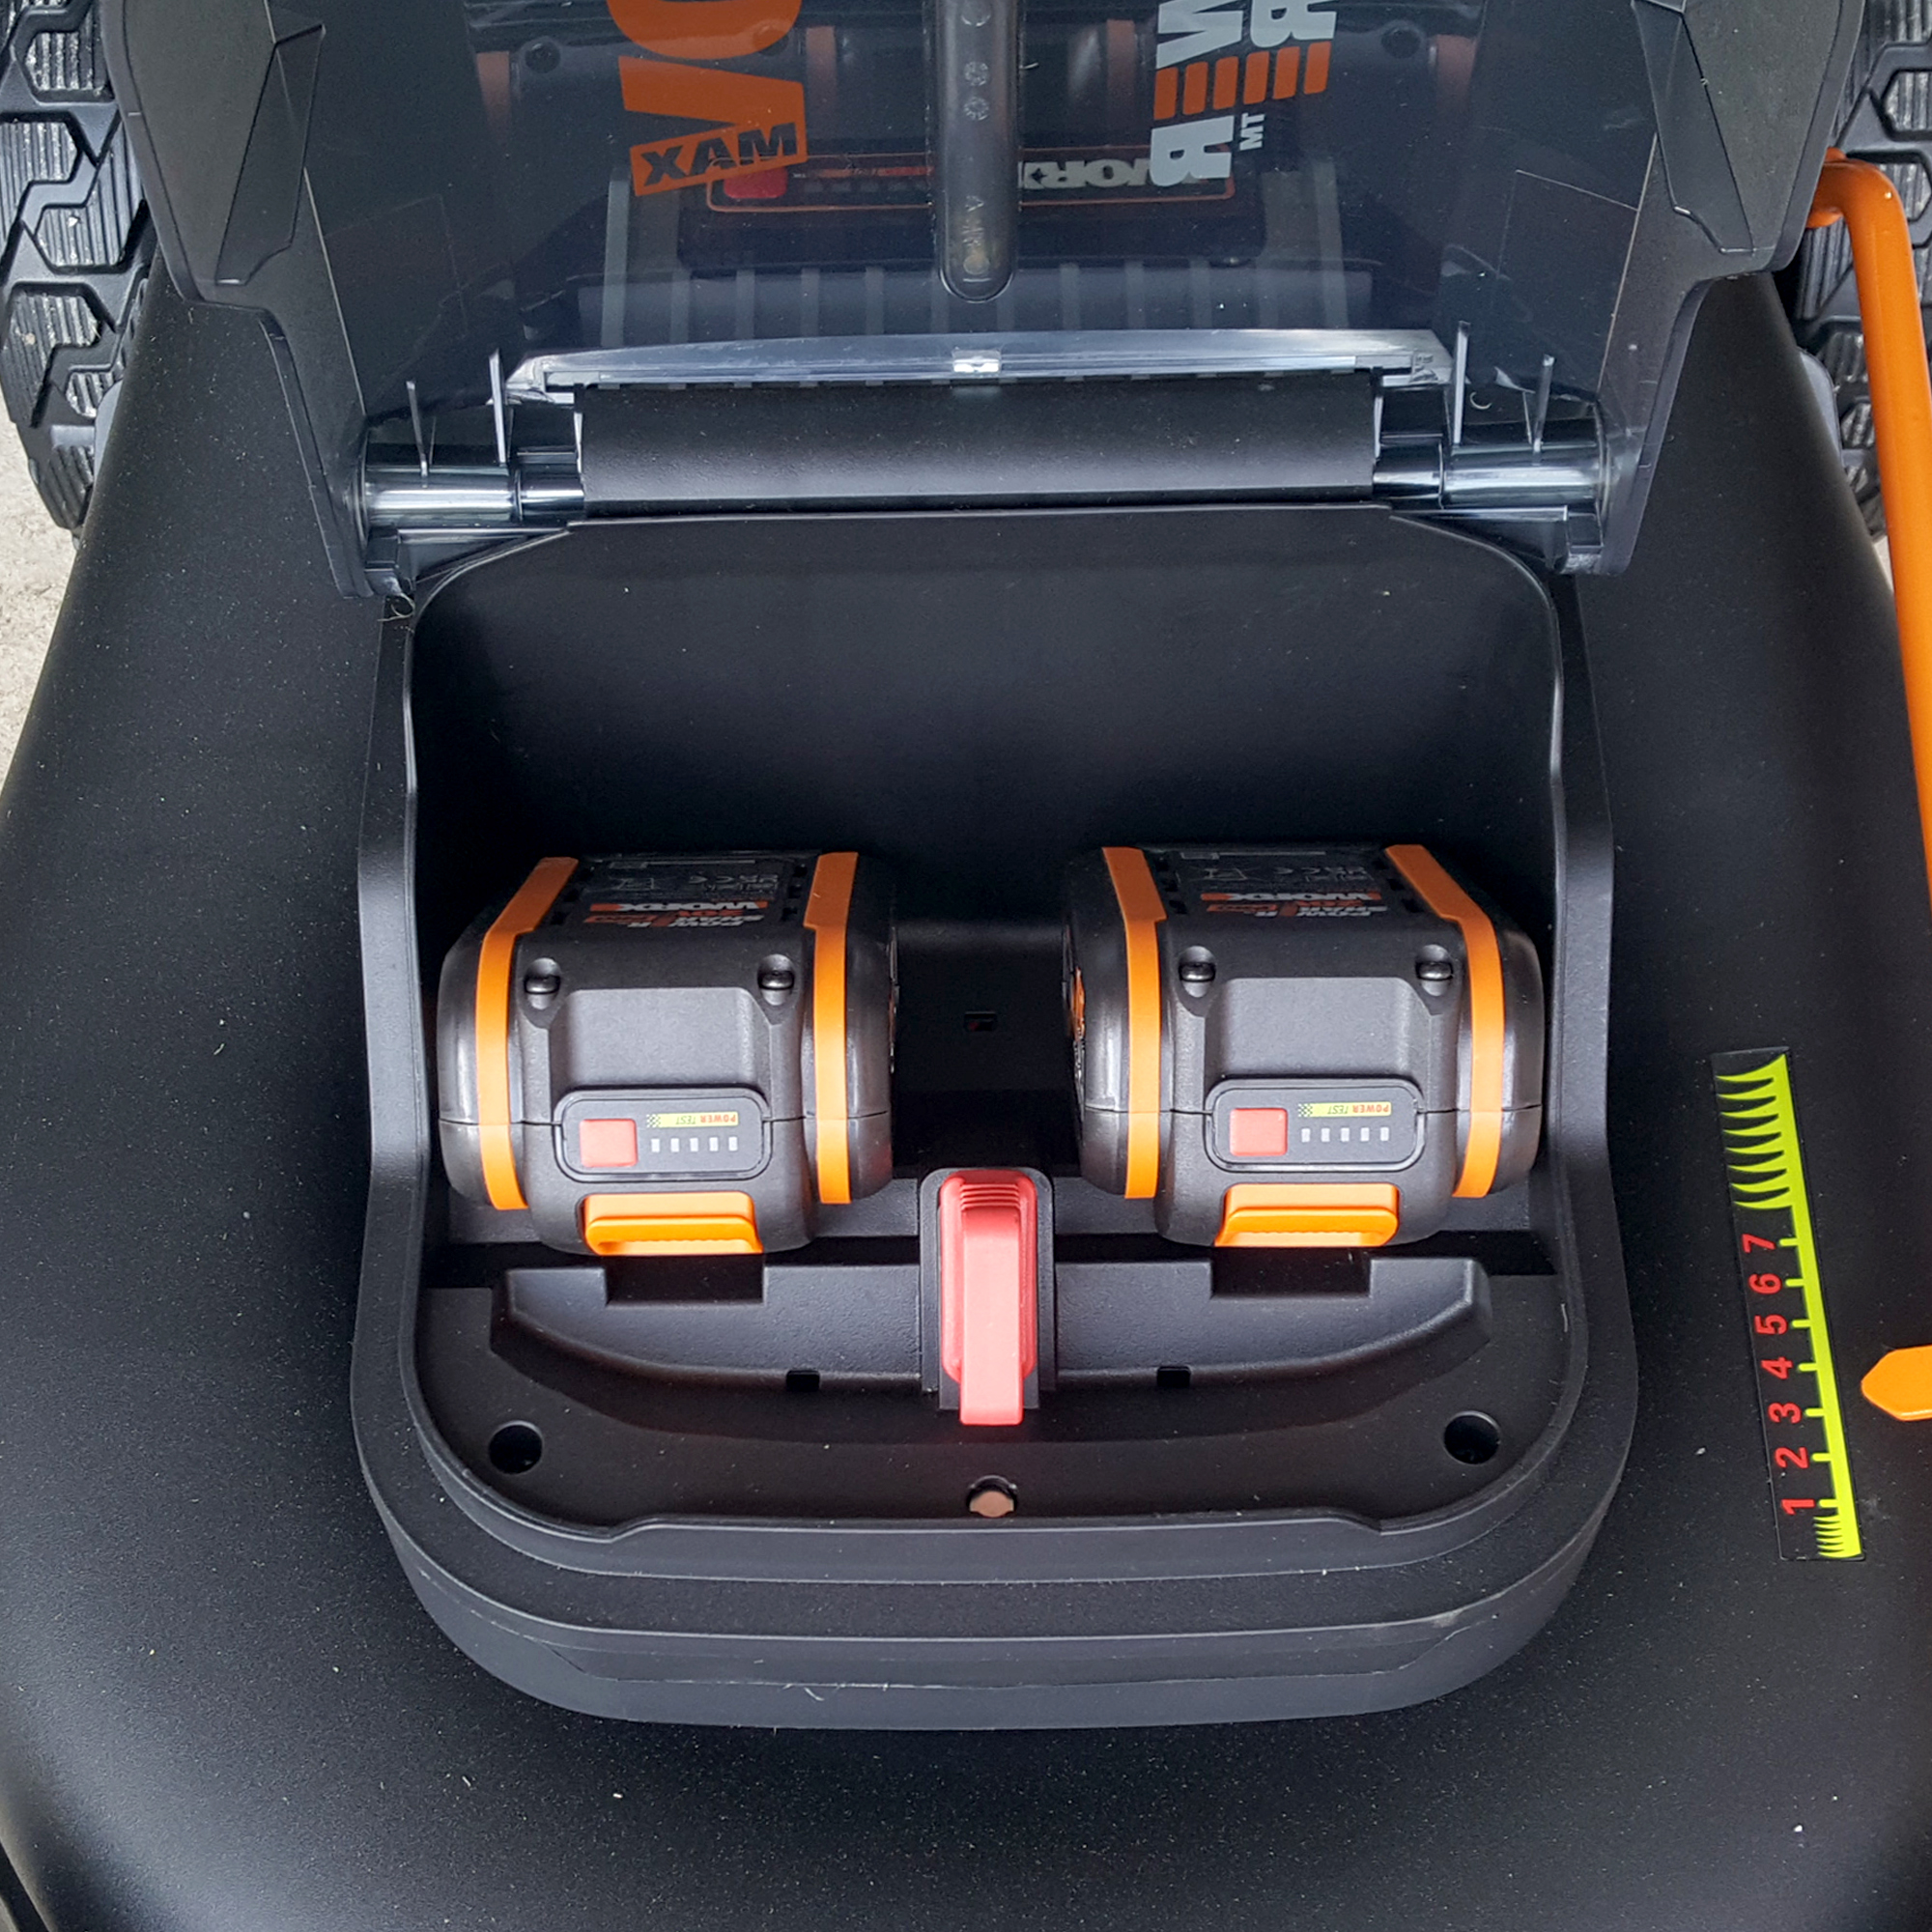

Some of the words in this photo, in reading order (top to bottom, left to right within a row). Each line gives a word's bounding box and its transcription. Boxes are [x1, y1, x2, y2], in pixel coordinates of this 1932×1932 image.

[618, 902, 759, 911] WORX
[1327, 1105, 1350, 1115] TEST
[1352, 1104, 1389, 1113] POWER
[675, 1115, 696, 1125] TEST
[699, 1114, 736, 1123] POWER
[1742, 1234, 1776, 1254] 7
[1748, 1272, 1782, 1294] 6
[1754, 1314, 1788, 1335] 5
[1761, 1356, 1793, 1379] 4
[1768, 1402, 1802, 1424] 3
[1775, 1446, 1809, 1468] 2
[1781, 1498, 1815, 1514] 1
